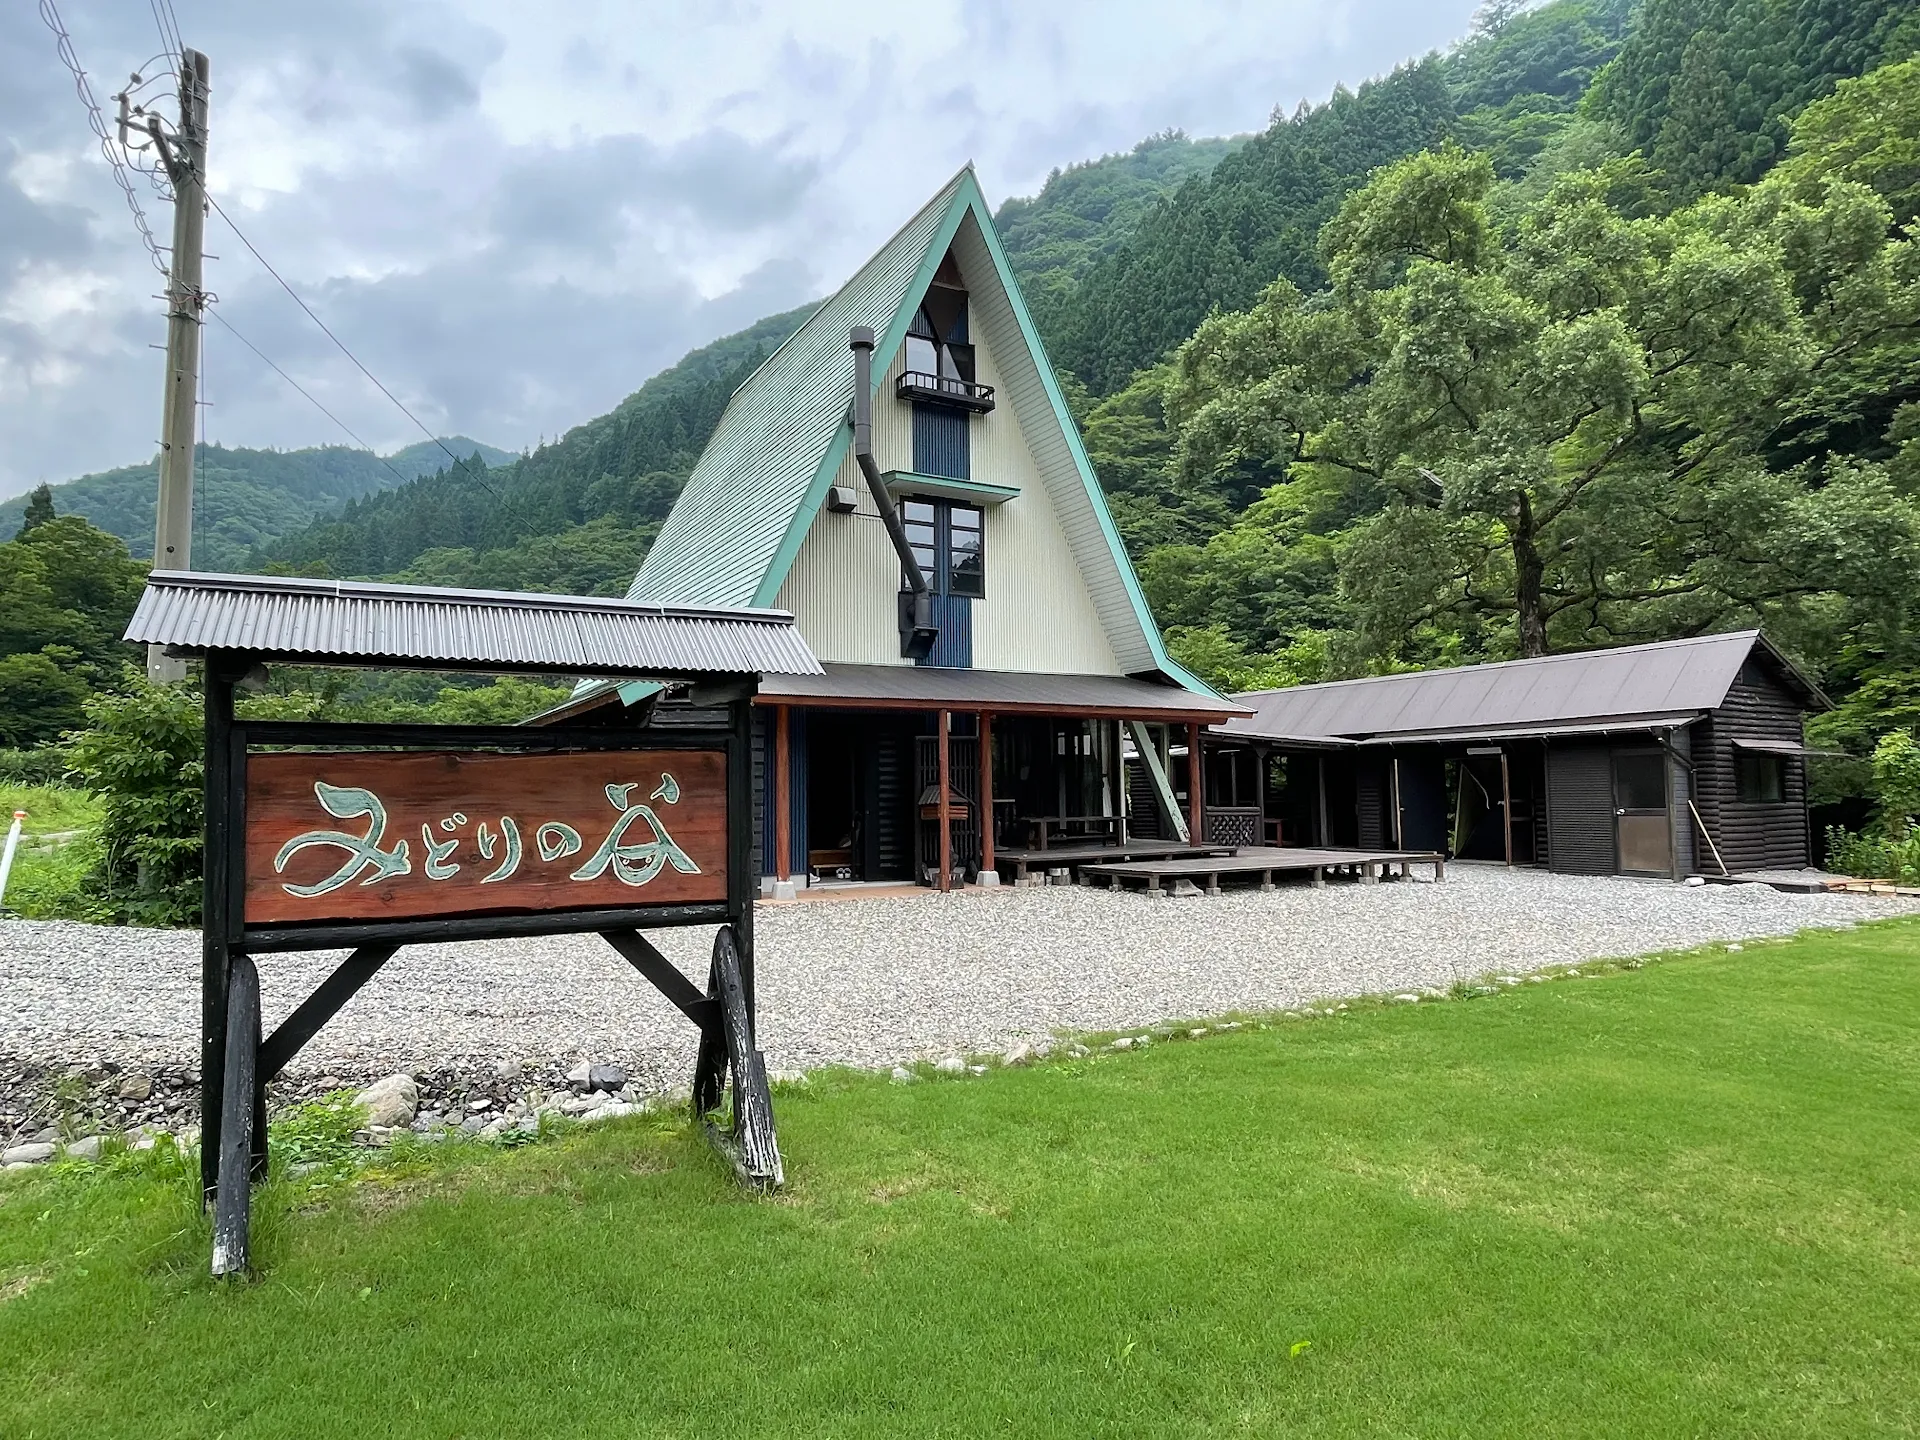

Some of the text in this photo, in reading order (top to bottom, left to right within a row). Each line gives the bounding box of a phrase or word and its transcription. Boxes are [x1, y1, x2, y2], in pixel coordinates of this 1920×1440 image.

[274, 772, 702, 897] みどりの谷
